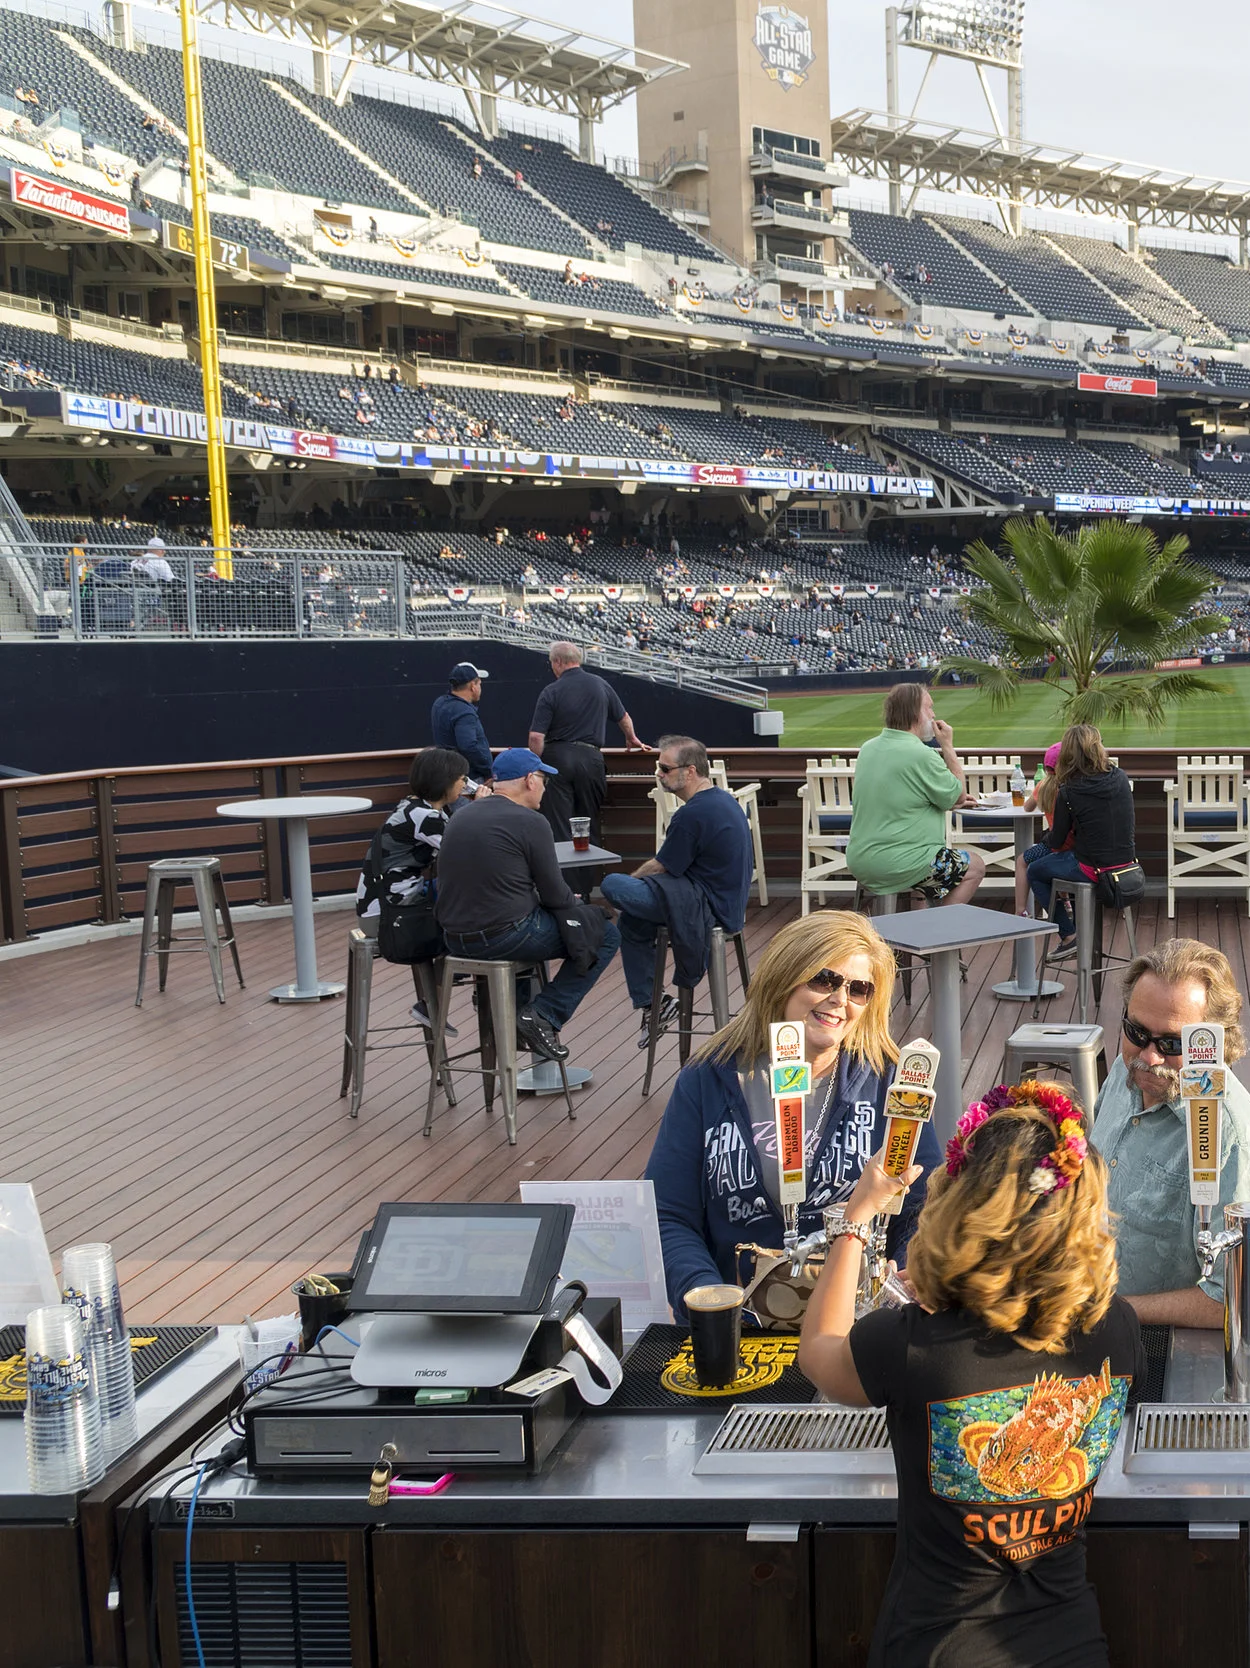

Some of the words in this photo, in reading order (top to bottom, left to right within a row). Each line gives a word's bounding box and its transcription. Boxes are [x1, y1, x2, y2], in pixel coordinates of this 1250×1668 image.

[768, 46, 801, 71] GAME
[18, 174, 84, 218] Tarantino
[84, 203, 130, 230] SAUSAGES
[698, 466, 738, 485] Sycuan
[788, 471, 867, 492] OPENING
[871, 476, 919, 495] WEEK
[1080, 496, 1113, 509] OPENING
[1113, 497, 1134, 510] WEEK
[776, 1043, 801, 1052] BALLAST
[1187, 1047, 1217, 1055] BALLAST
[900, 1069, 931, 1079] BALLAST
[904, 1076, 926, 1084] POINT
[784, 1104, 792, 1165] WATERMELON
[791, 1115, 799, 1153] DORADO
[899, 1129, 912, 1152] KEEL
[1198, 1106, 1210, 1160] GRUNION
[887, 1134, 902, 1168] MANGO
[894, 1152, 907, 1177] EVEN
[30, 1363, 49, 1373] GAME
[62, 1362, 83, 1377] GAME
[414, 1368, 448, 1377] micros
[962, 1488, 1095, 1545] SCULPIN
[996, 1547, 1030, 1562] INDIA
[1030, 1538, 1053, 1556] PALE
[1055, 1531, 1077, 1548] ALE
